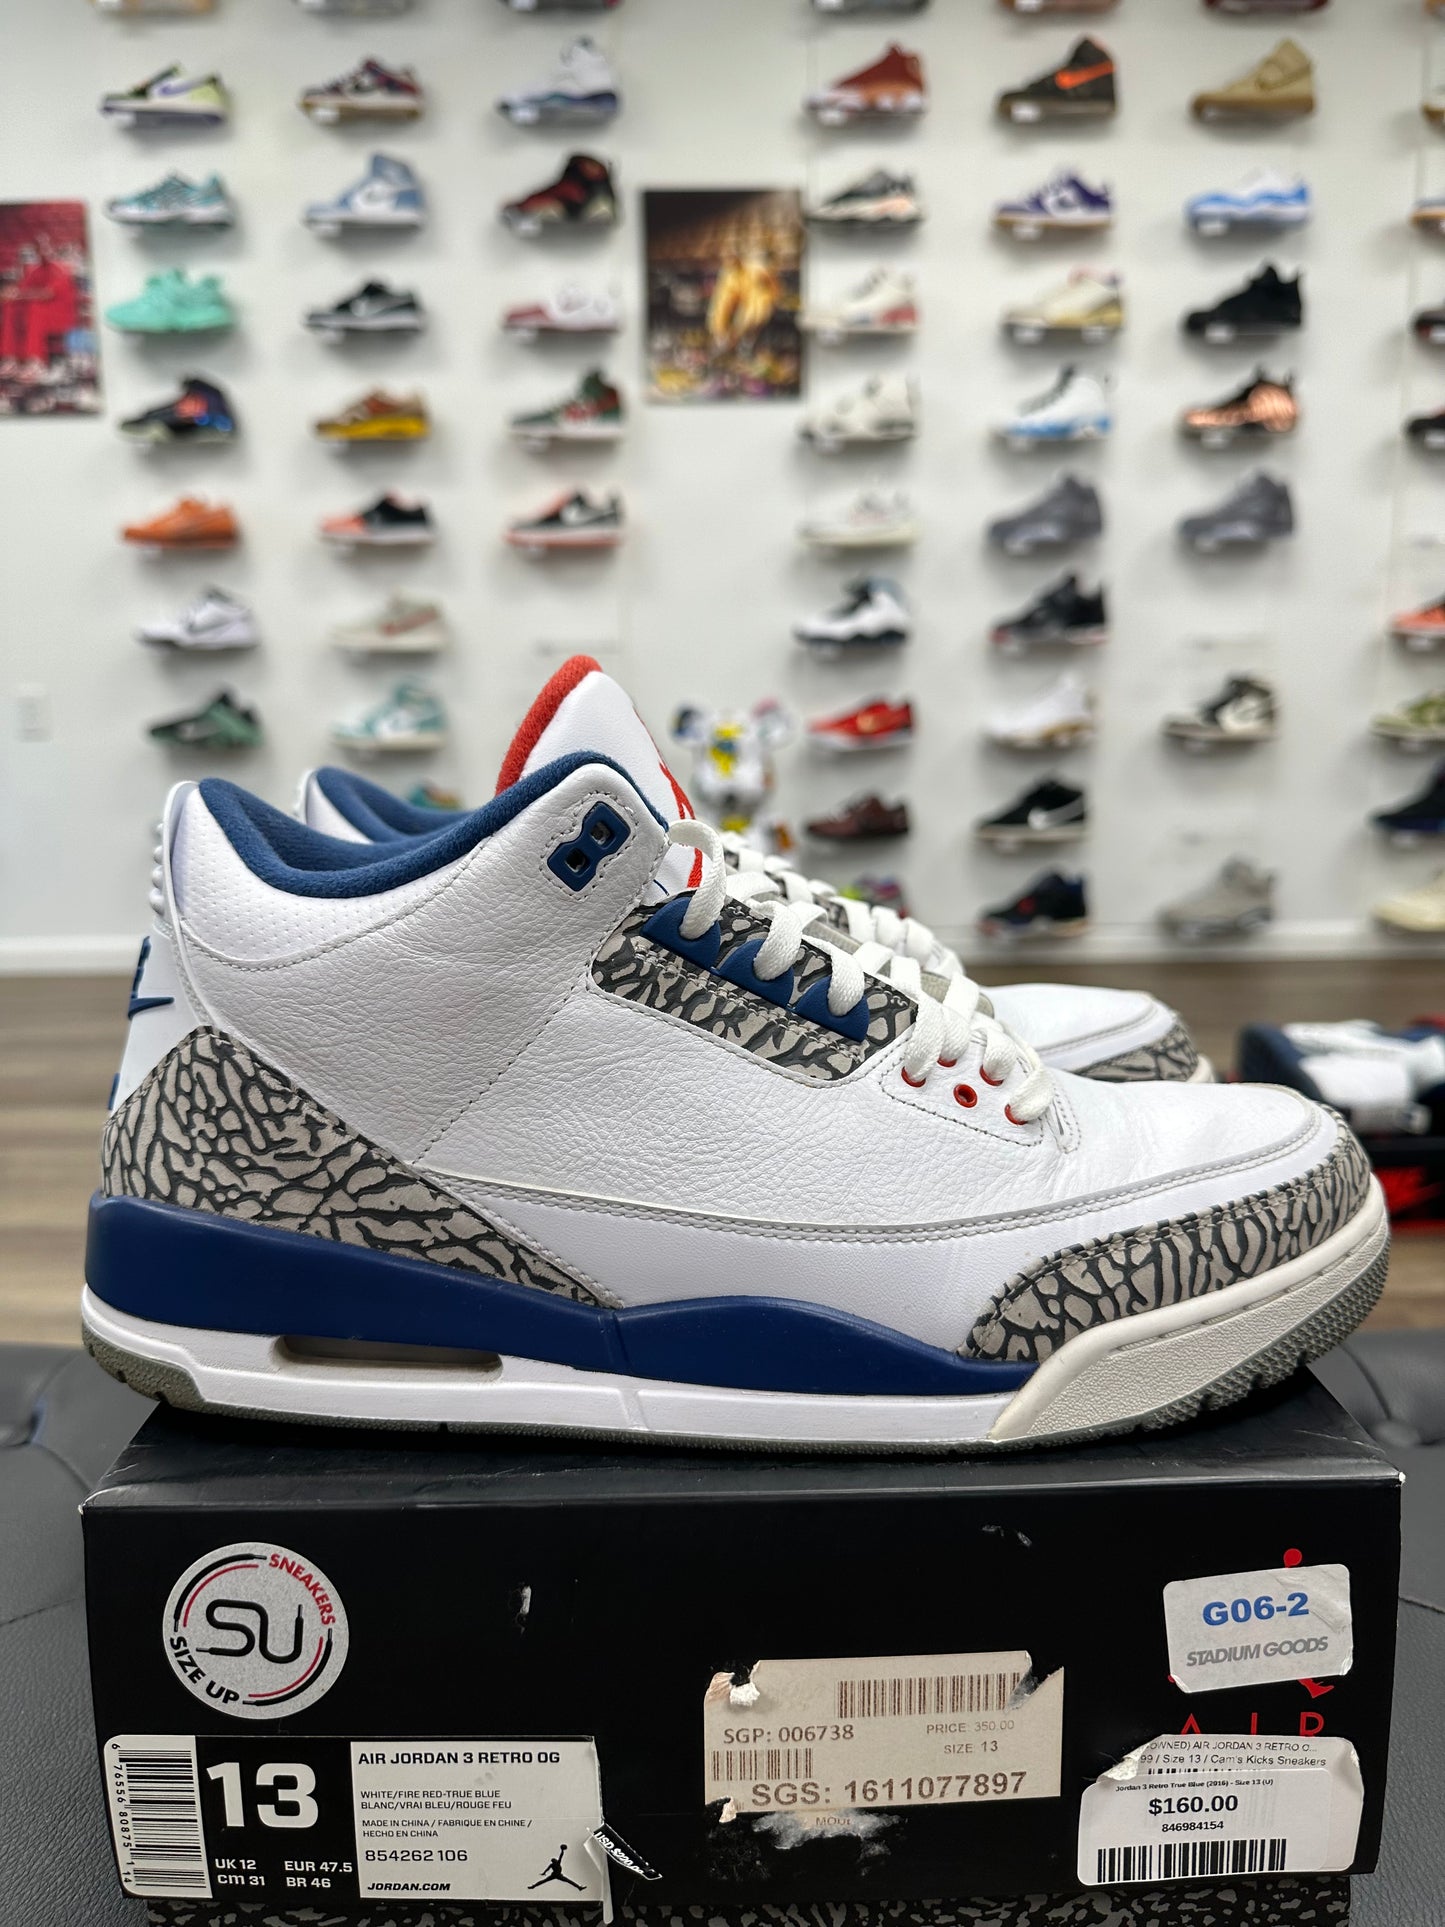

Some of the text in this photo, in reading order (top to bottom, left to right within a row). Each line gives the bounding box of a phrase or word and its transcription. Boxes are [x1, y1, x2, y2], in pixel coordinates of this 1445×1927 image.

[269, 1553, 336, 1626] SNEAKERS
[1203, 1592, 1309, 1626] G06-2
[1186, 1636, 1328, 1667] STADIUM GOODS
[170, 1636, 240, 1705] SIZE UP
[723, 1724, 855, 1744] SGP: 006738
[981, 1740, 999, 1752] 13
[1148, 1741, 1191, 1750] OWNED)
[1193, 1741, 1210, 1750] AIR
[1212, 1741, 1253, 1750] JORDAN
[1256, 1742, 1261, 1750] 3
[1264, 1742, 1299, 1751] RETRO
[358, 1752, 560, 1764] AIR JORDAN 3 RETRO OG
[1163, 1754, 1185, 1764] Size
[1189, 1754, 1201, 1763] 13
[1210, 1754, 1243, 1764] Cam's
[1246, 1755, 1274, 1765] Kicks
[1277, 1755, 1327, 1766] Sneakers
[114, 1764, 126, 1803] 76556
[752, 1771, 1028, 1807] SGS: 1611077897
[1116, 1784, 1141, 1792] Jordan
[206, 1762, 319, 1828] 13
[361, 1790, 500, 1799] WHITE/FIRE RED-TRUE BLUE
[361, 1801, 512, 1810] BLANC/VRAI BLEU/ROUGE FEU
[1148, 1795, 1238, 1816] $160.00
[119, 1811, 132, 1848] 80875
[362, 1819, 388, 1827] MADE
[390, 1819, 399, 1827] IN
[401, 1819, 429, 1827] CHINA
[437, 1819, 482, 1828] FABRIQUE
[484, 1819, 496, 1827] EN
[498, 1819, 526, 1827] CHINE
[1162, 1821, 1224, 1833] 846984154
[363, 1830, 394, 1838] HECHO
[396, 1830, 408, 1838] EN
[365, 1850, 468, 1862] 854262 106
[215, 1858, 257, 1870] UK 12
[284, 1861, 353, 1873] EUR 47.5
[250, 1876, 265, 1886] 31
[286, 1877, 331, 1888] BR 46
[367, 1883, 451, 1891] JORDAN.COM
